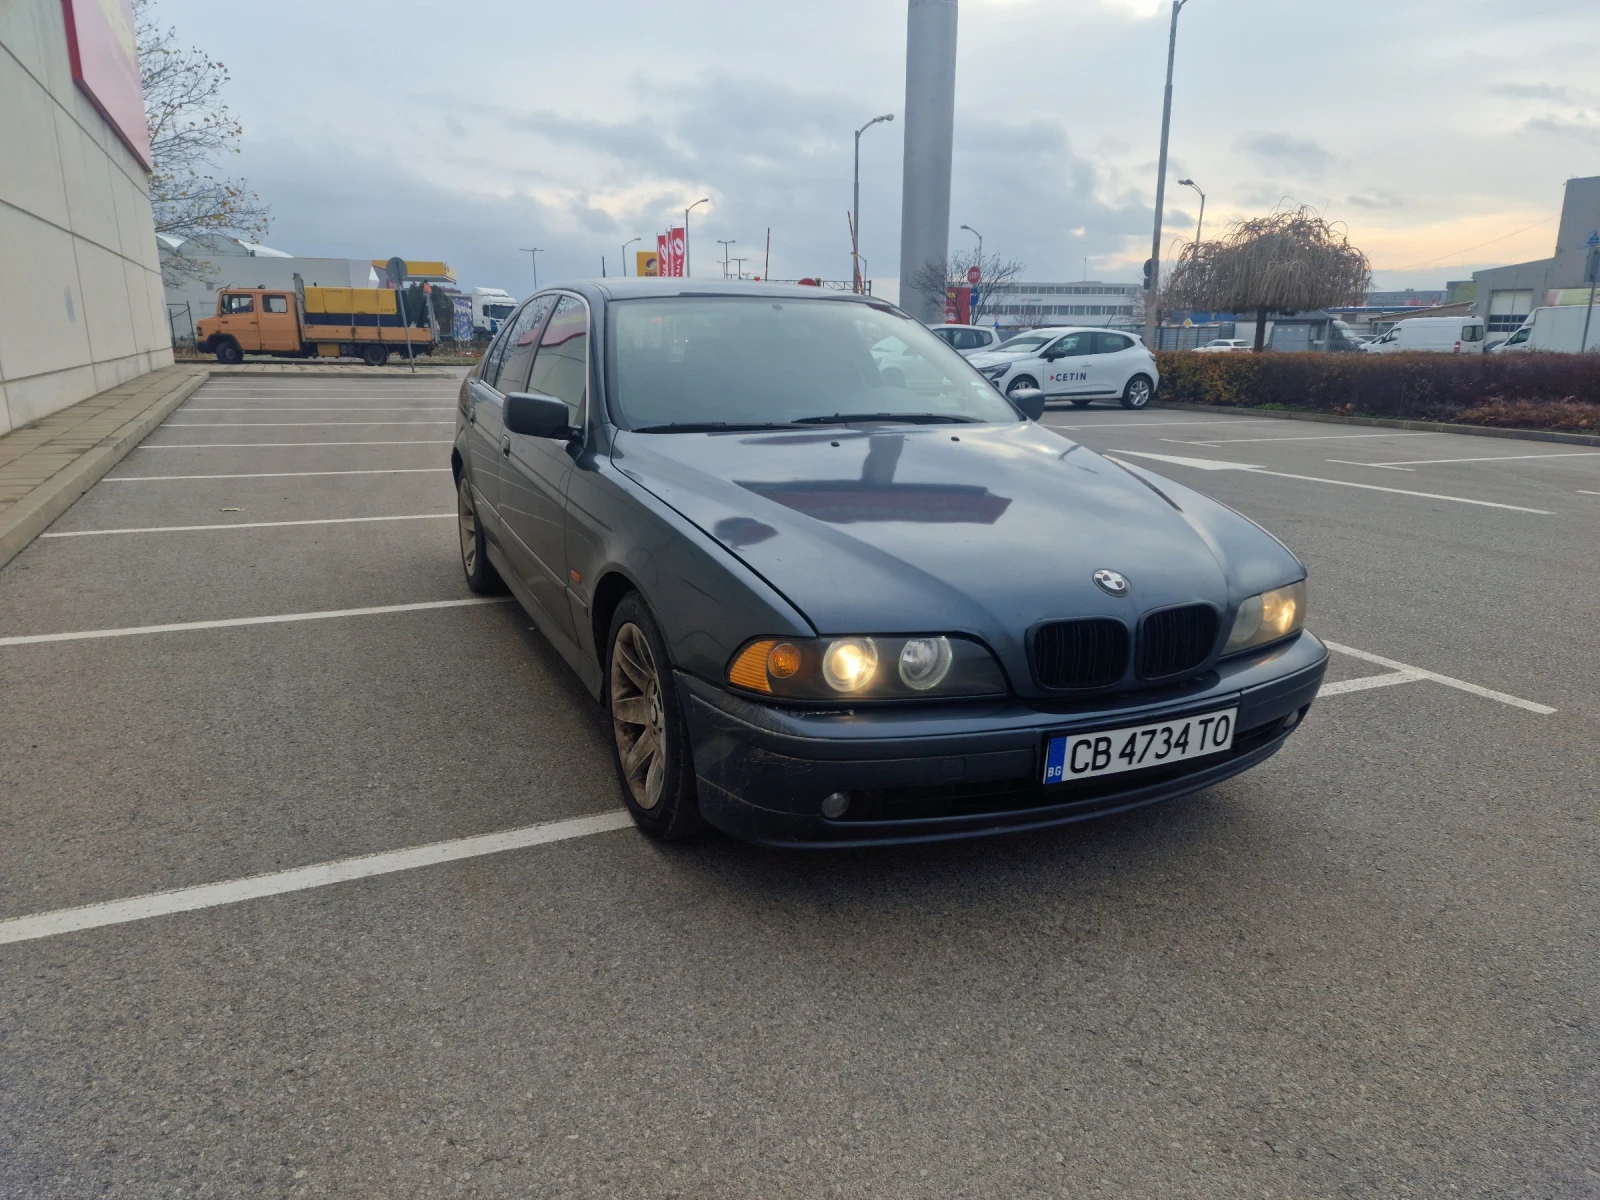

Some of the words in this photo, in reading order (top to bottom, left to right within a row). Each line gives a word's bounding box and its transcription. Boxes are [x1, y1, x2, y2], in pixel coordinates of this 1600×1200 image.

[1055, 372, 1087, 382] CETIN
[1070, 736, 1112, 774] CB
[1119, 722, 1191, 765] 4734
[1198, 714, 1231, 751] TO
[1047, 766, 1062, 777] BG
